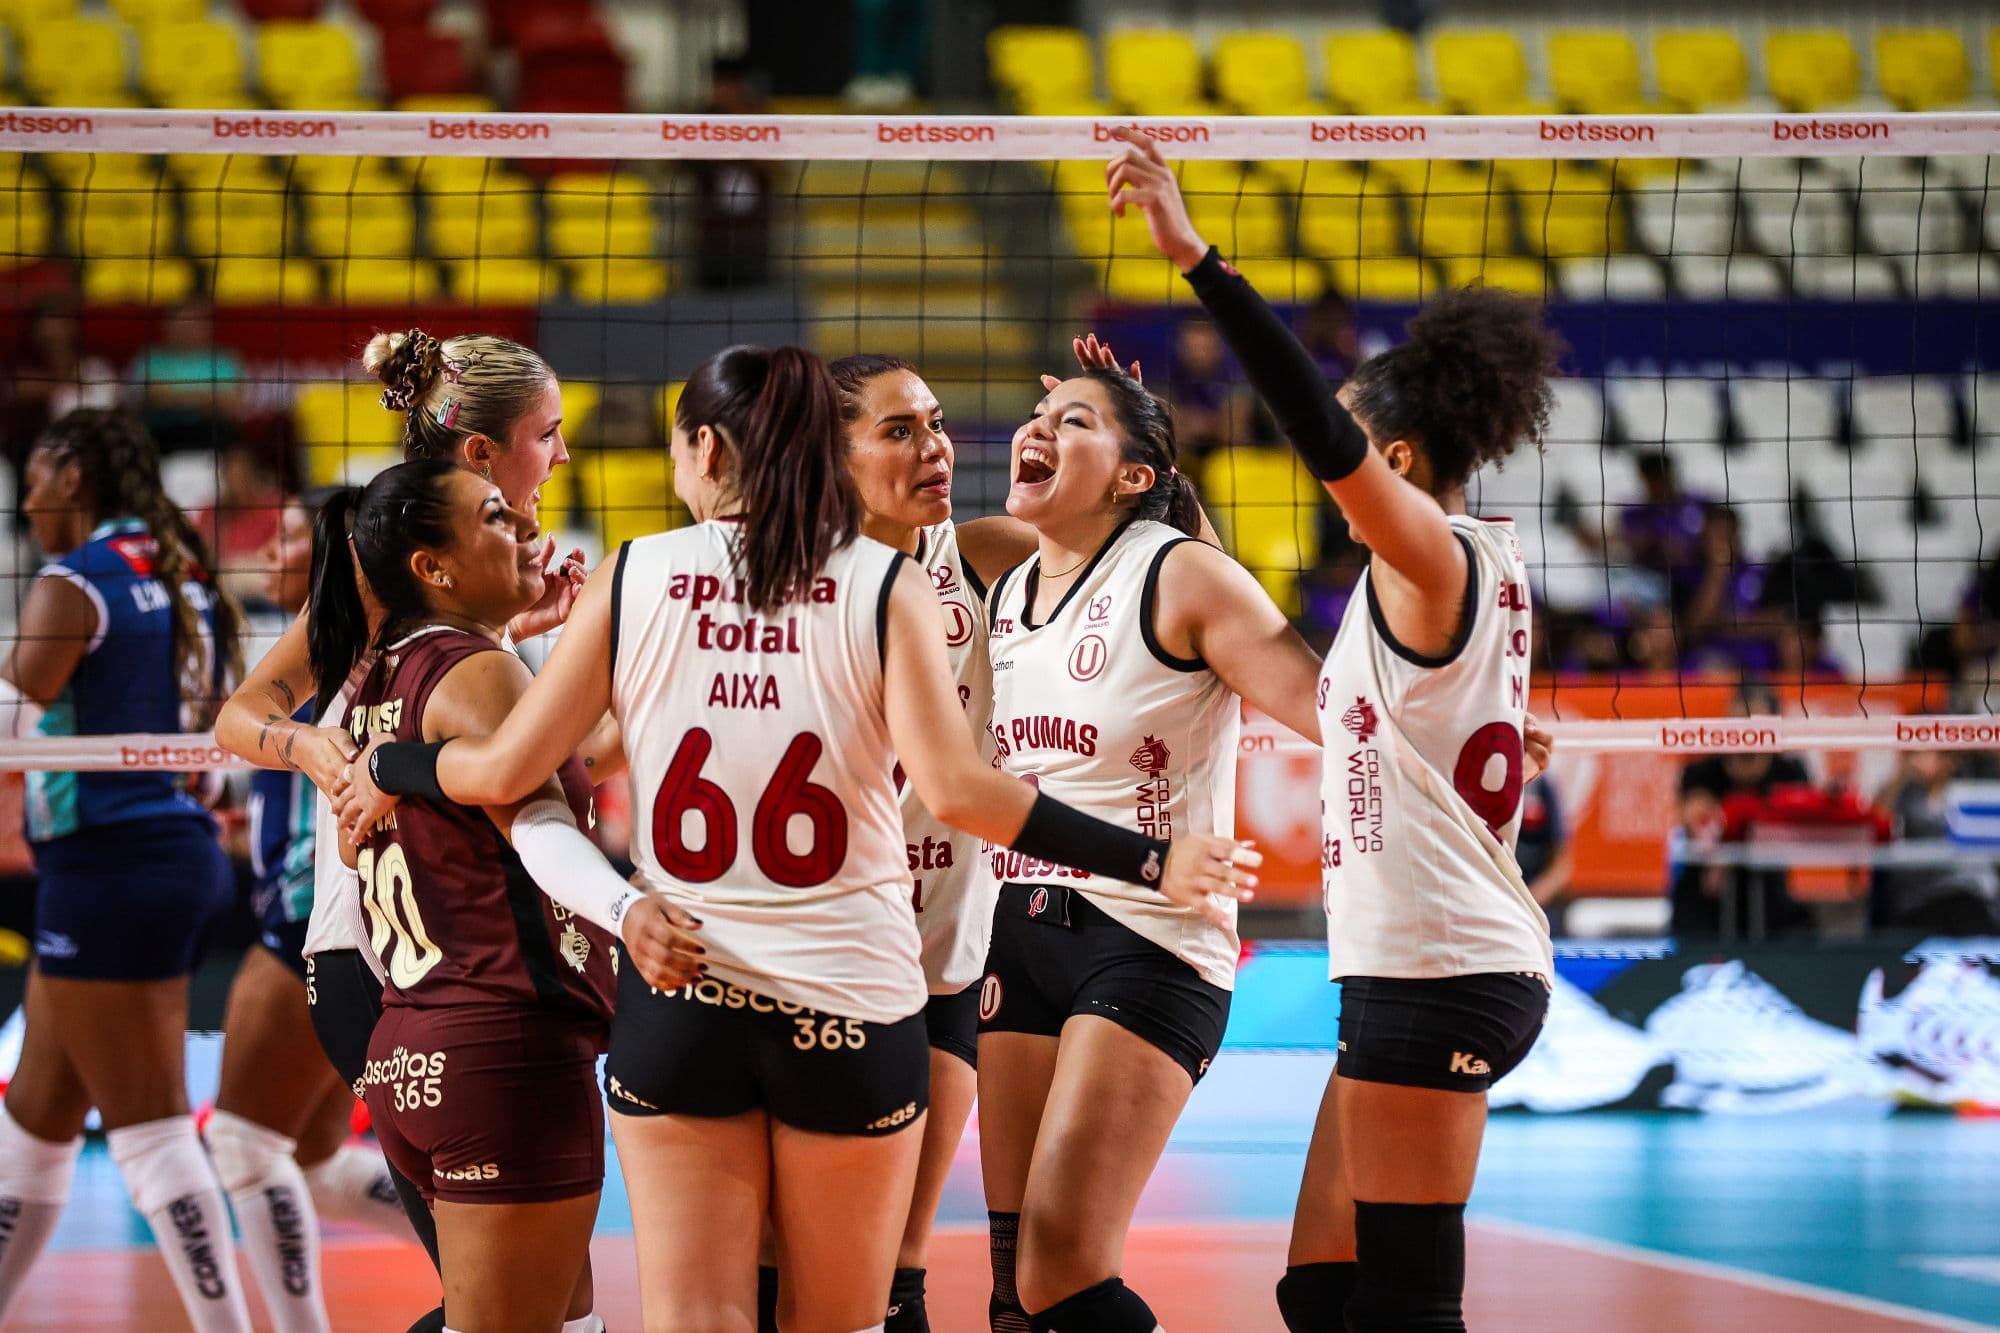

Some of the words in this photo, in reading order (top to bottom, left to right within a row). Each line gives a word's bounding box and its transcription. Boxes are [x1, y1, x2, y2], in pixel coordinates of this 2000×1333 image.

[213, 117, 336, 138] betsson
[429, 120, 549, 140] betsson
[661, 121, 780, 142] betsson
[877, 123, 995, 143] betsson
[1311, 121, 1426, 142] betsson
[1539, 121, 1655, 142] betsson
[1773, 119, 1889, 141] betsson
[697, 613, 801, 654] total
[707, 672, 781, 710] AIXA
[1011, 715, 1098, 757] PUMAS
[1661, 725, 1777, 746] betsson
[121, 745, 233, 767] betsso
[652, 726, 849, 889] 66
[1347, 750, 1367, 854] WORLD
[1366, 749, 1384, 853] COLECTIVO
[793, 1017, 866, 1050] 365
[363, 1046, 447, 1085] ascotas
[393, 1077, 442, 1113] 365
